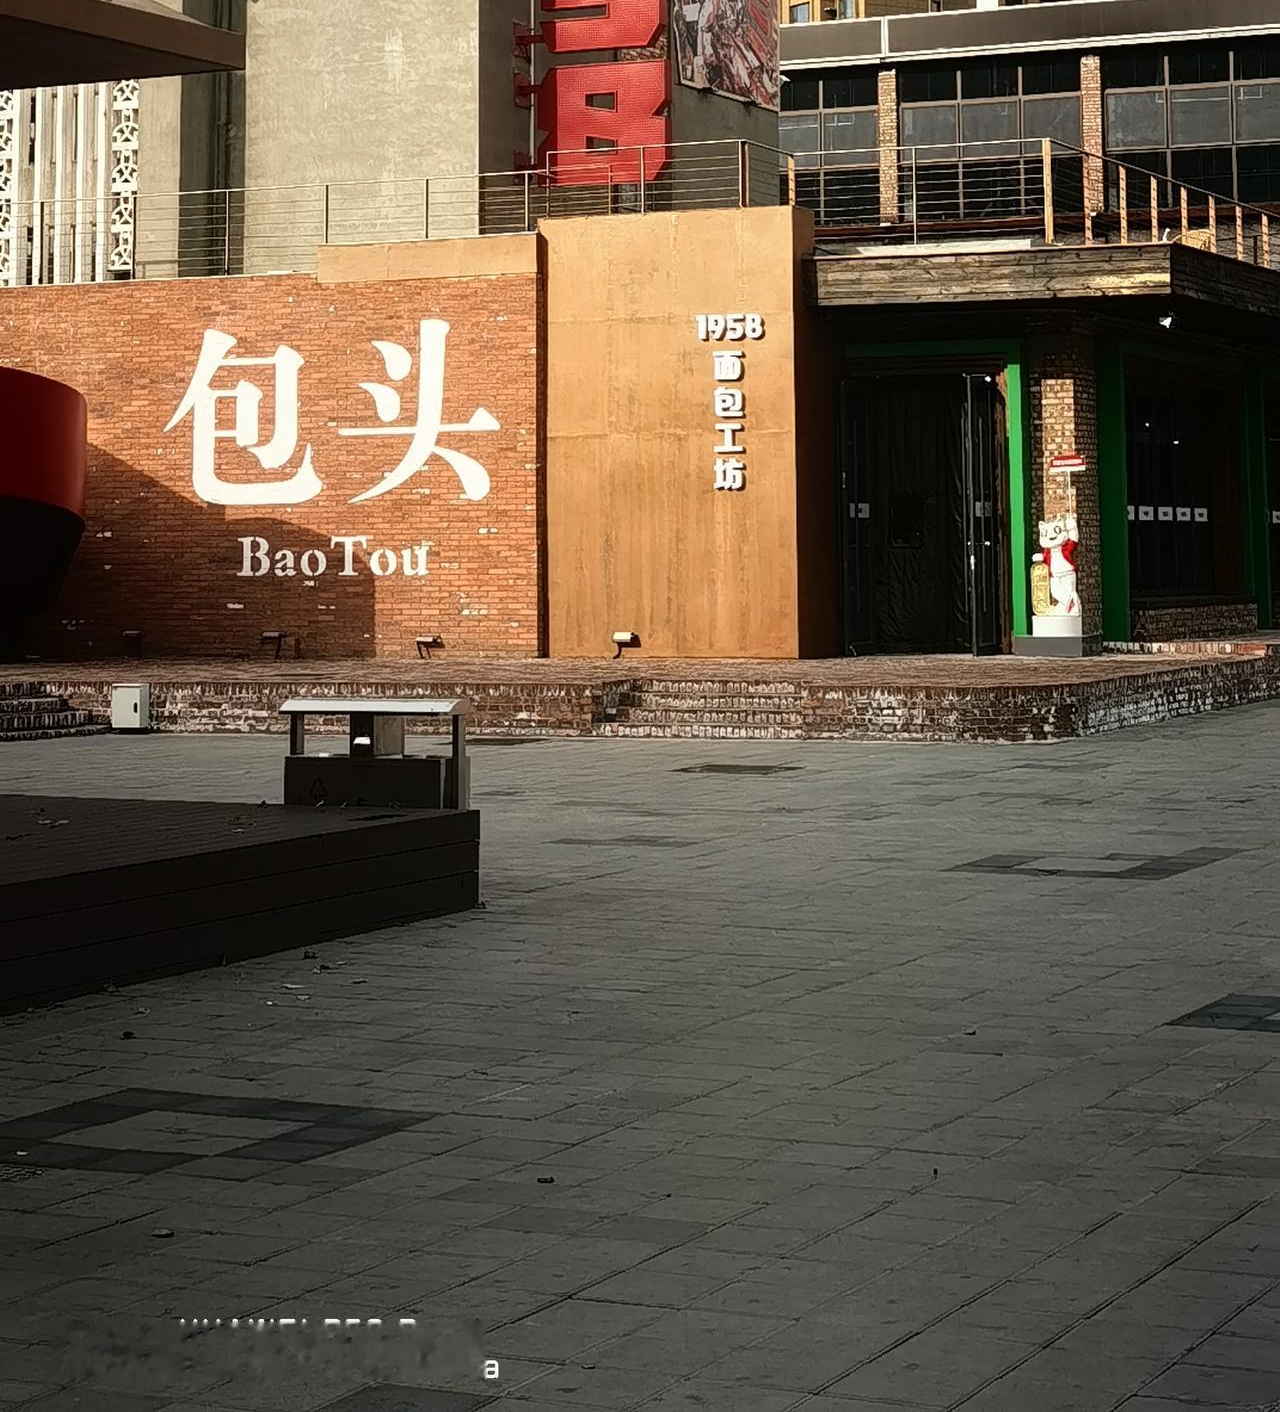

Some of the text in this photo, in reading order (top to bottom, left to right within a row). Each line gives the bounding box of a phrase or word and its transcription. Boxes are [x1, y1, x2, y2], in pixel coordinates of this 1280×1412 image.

[695, 313, 764, 340] 1958
[163, 318, 501, 505] 包头
[713, 351, 745, 490] 面包工坊
[236, 536, 433, 578] BaoTou
